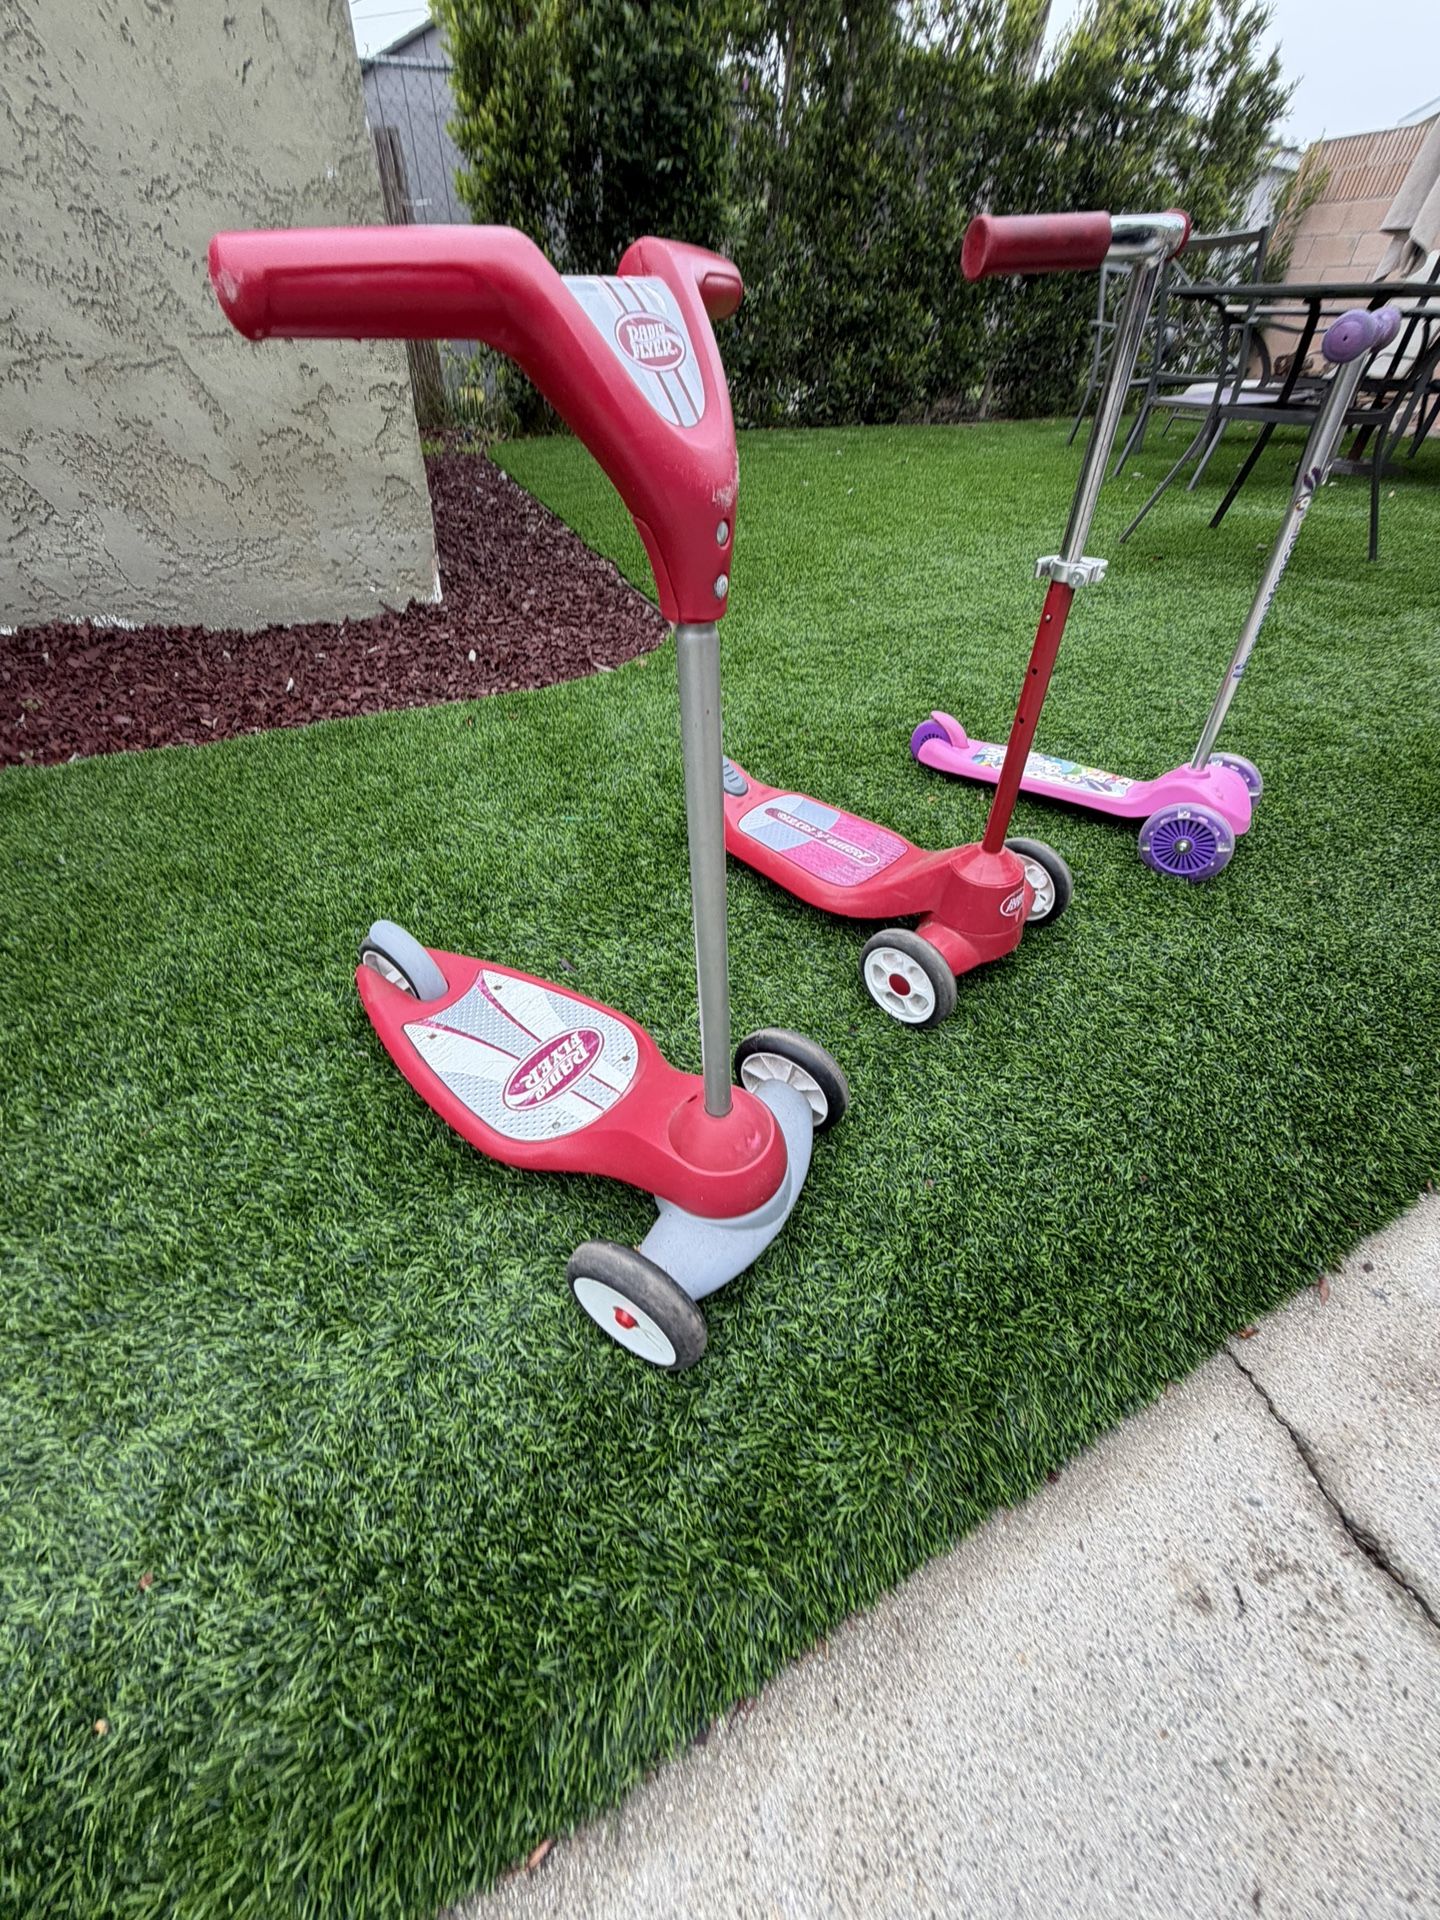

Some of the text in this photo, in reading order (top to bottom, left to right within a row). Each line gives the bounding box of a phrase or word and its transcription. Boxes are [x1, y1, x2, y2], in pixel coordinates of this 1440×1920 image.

[626, 323, 666, 341] RADIO
[630, 339, 674, 360] FLYER
[519, 1032, 584, 1089] FLYER
[534, 1040, 590, 1101] RADIO
